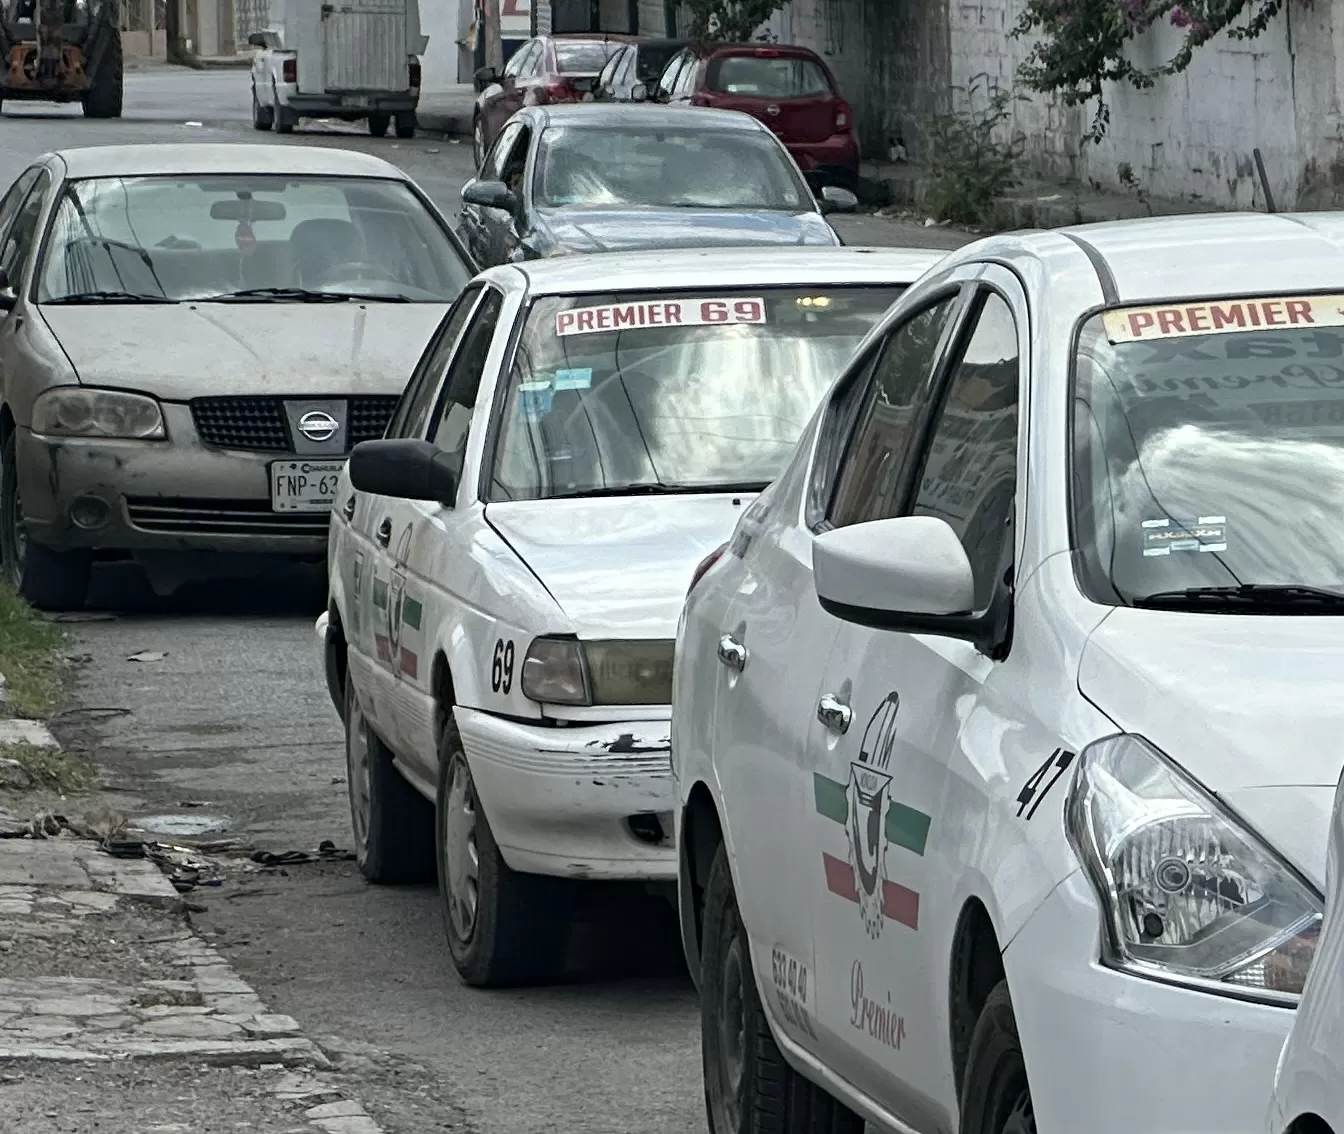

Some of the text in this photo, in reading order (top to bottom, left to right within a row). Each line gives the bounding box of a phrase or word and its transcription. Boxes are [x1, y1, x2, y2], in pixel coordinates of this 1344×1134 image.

[557, 301, 761, 334] PREMIER 69
[1127, 300, 1315, 337] PREMIER
[491, 637, 515, 695] 69
[1015, 747, 1076, 821] 47
[850, 959, 907, 1051] Premier
